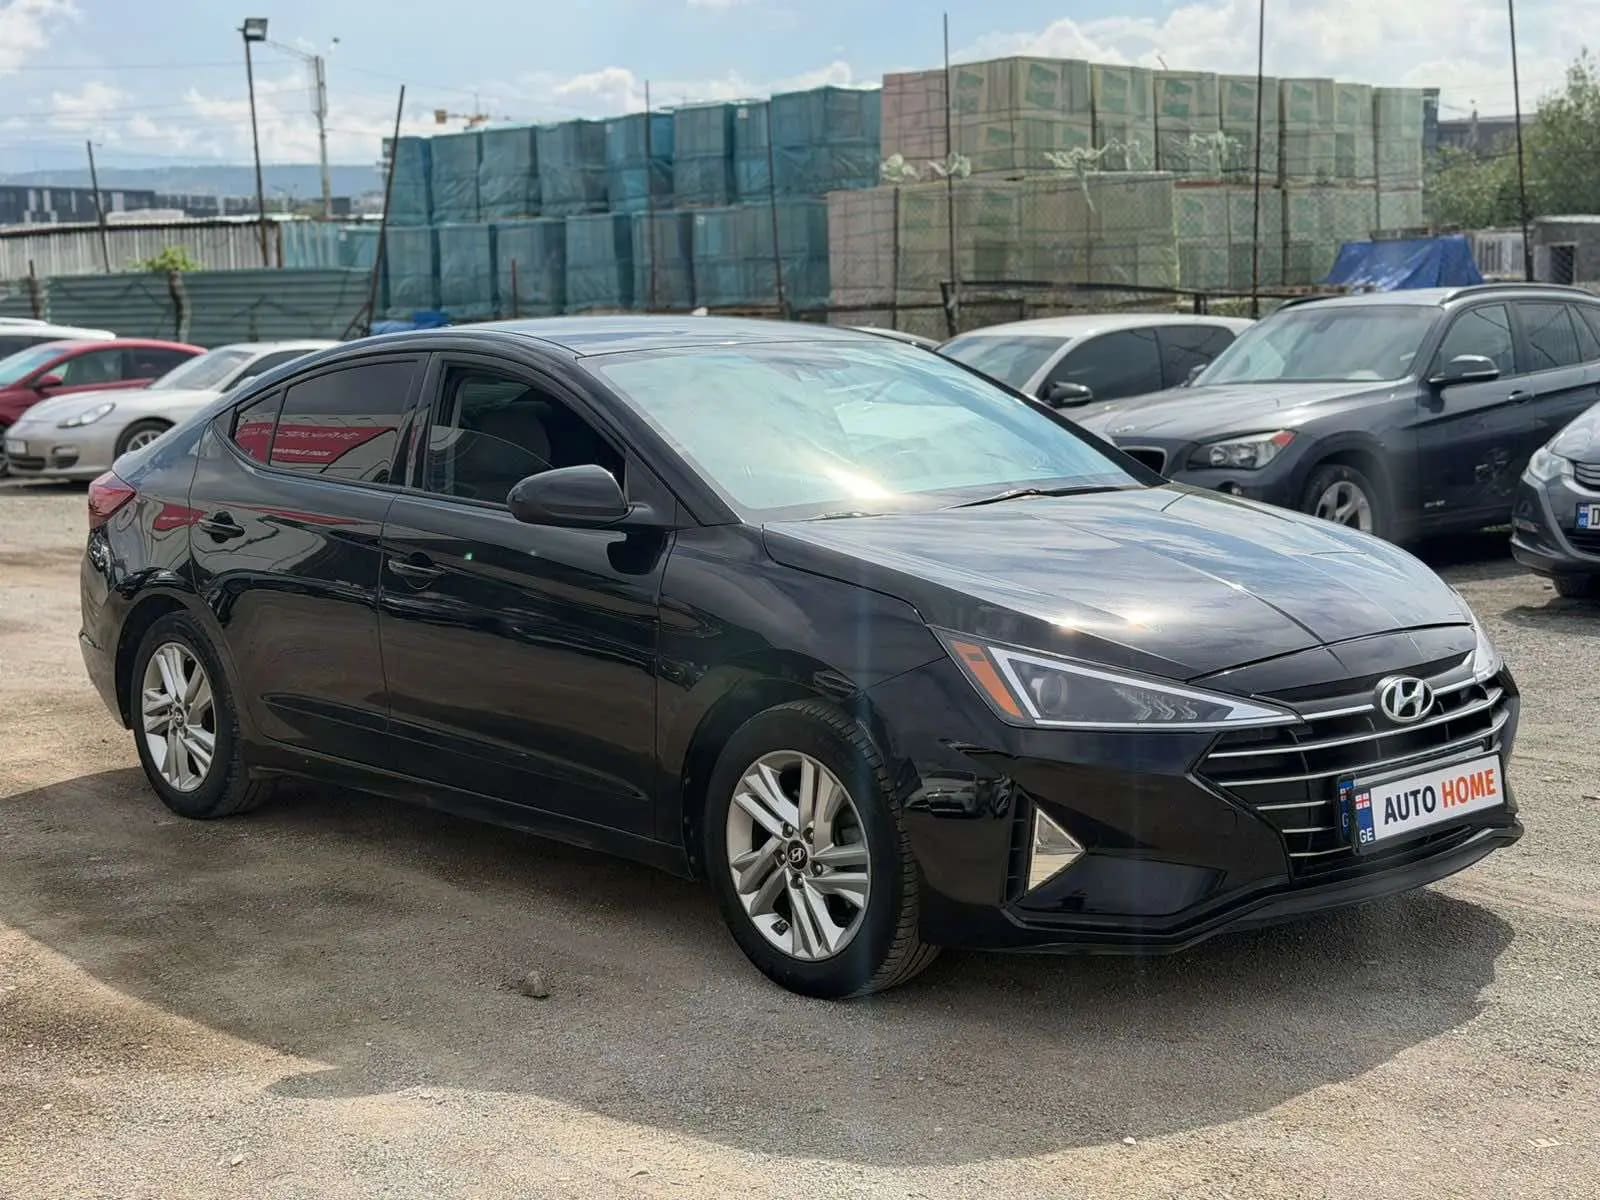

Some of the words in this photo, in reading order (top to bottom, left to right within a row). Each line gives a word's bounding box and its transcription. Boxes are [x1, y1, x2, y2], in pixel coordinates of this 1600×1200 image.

[1384, 785, 1436, 825] AUTO
[1441, 768, 1497, 808] HOME
[1359, 827, 1374, 844] GE
